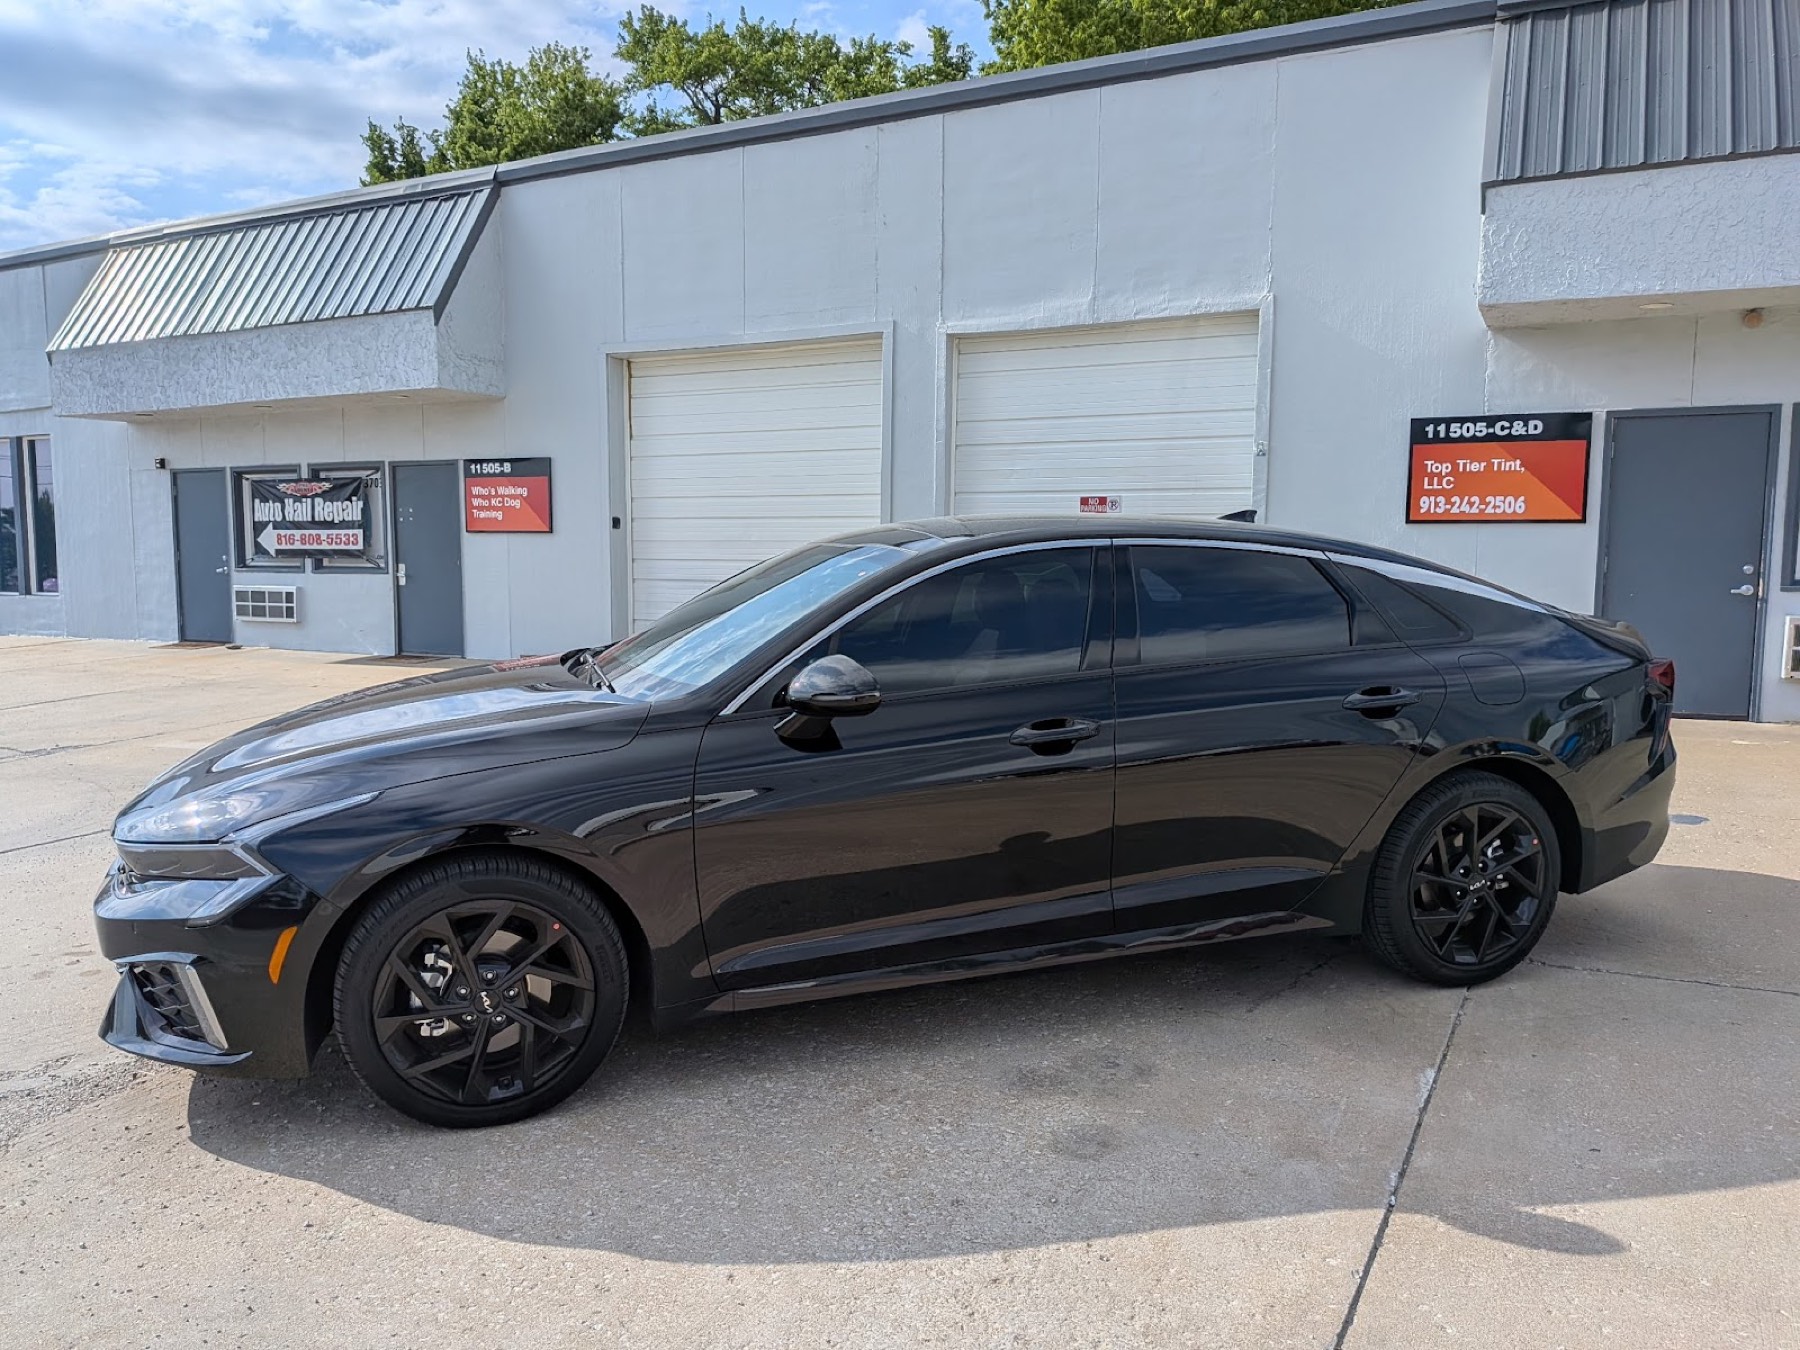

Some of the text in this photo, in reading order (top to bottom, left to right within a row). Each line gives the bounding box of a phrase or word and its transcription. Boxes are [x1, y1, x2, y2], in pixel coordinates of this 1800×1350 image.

[1425, 420, 1543, 438] 11505-C&D
[470, 462, 512, 474] 11505-B
[1424, 458, 1525, 475] Top Tier Tint,
[1424, 476, 1455, 489] LLC
[471, 486, 528, 497] Who's Walking
[471, 497, 521, 509] Who KC Dog
[1088, 497, 1100, 505] NO
[1420, 496, 1525, 514] 913-242-2506
[254, 496, 363, 523] Auto Hail Repair
[1081, 504, 1107, 512] PARKING
[472, 509, 503, 520] Training
[276, 533, 359, 546] 816-808-5533
